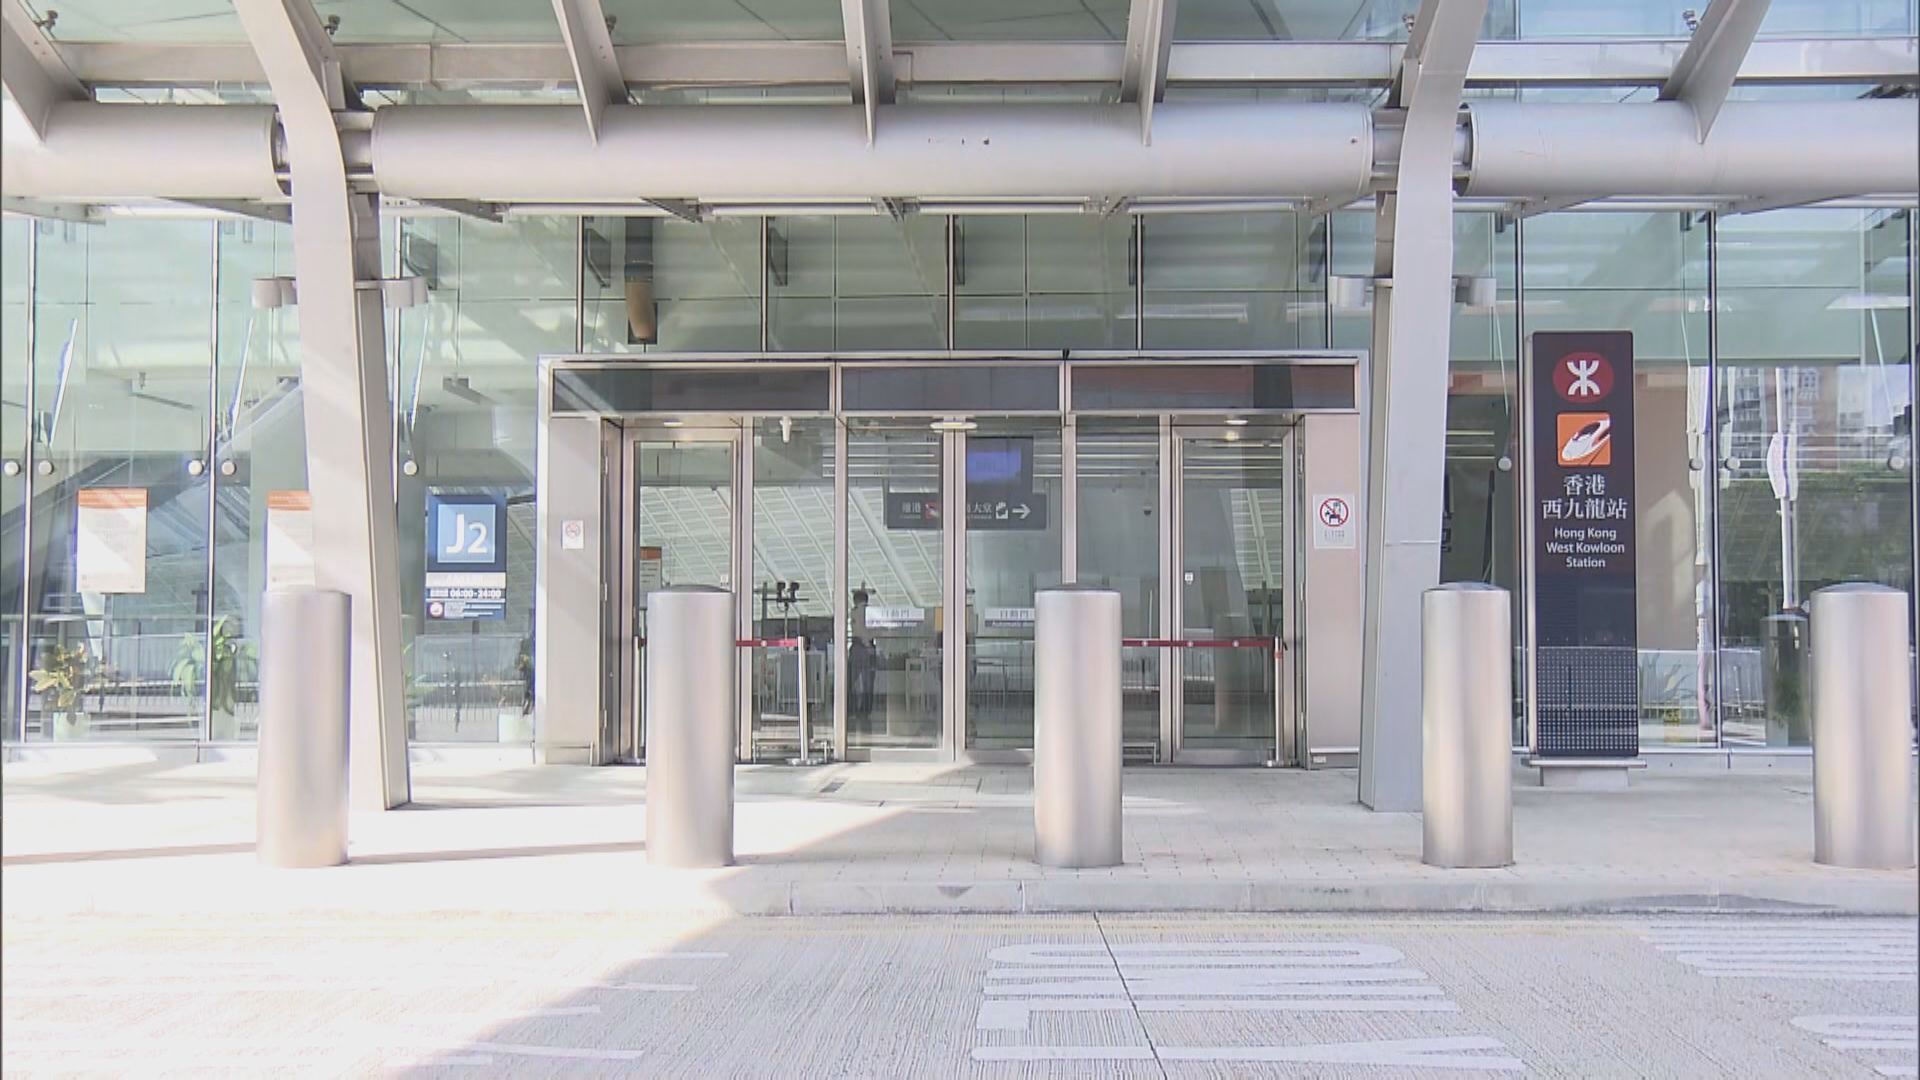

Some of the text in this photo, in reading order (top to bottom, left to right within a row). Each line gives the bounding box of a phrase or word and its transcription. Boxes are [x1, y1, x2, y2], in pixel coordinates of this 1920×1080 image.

[1563, 474, 1605, 496] 香港
[1541, 498, 1628, 519] 西九龍站
[446, 512, 488, 554] J2
[1554, 527, 1617, 541] Hong Kong
[1546, 541, 1625, 553] West Kowloon
[1566, 556, 1606, 567] Station
